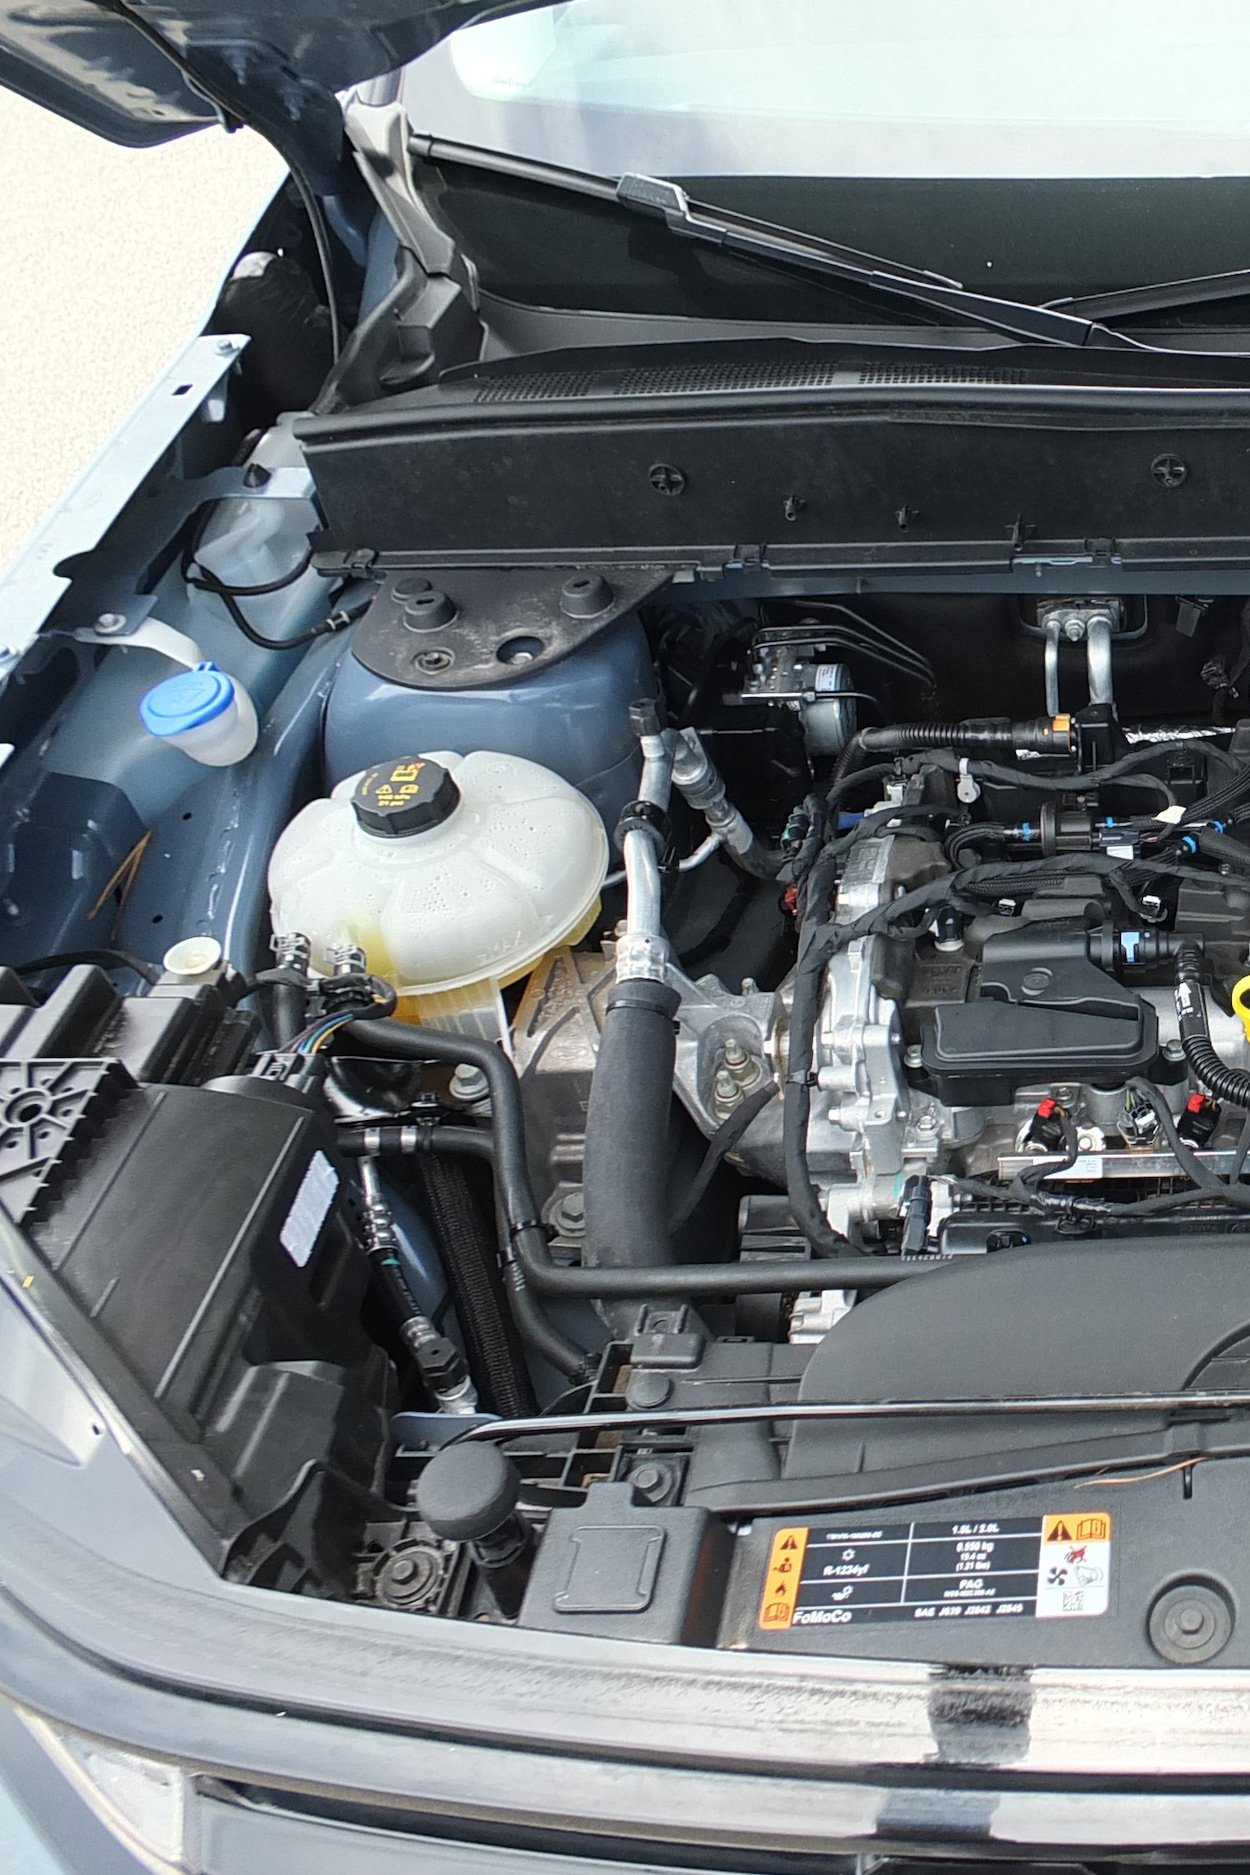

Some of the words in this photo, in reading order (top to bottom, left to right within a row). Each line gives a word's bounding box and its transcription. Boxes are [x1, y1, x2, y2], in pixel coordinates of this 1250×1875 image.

[978, 1523, 1001, 1534] 2.0L
[981, 1541, 995, 1553] kg
[823, 1564, 870, 1577] R-1234yf
[959, 1578, 984, 1589] PAG
[791, 1609, 853, 1625] FoMoCo
[914, 1607, 936, 1618] SAE
